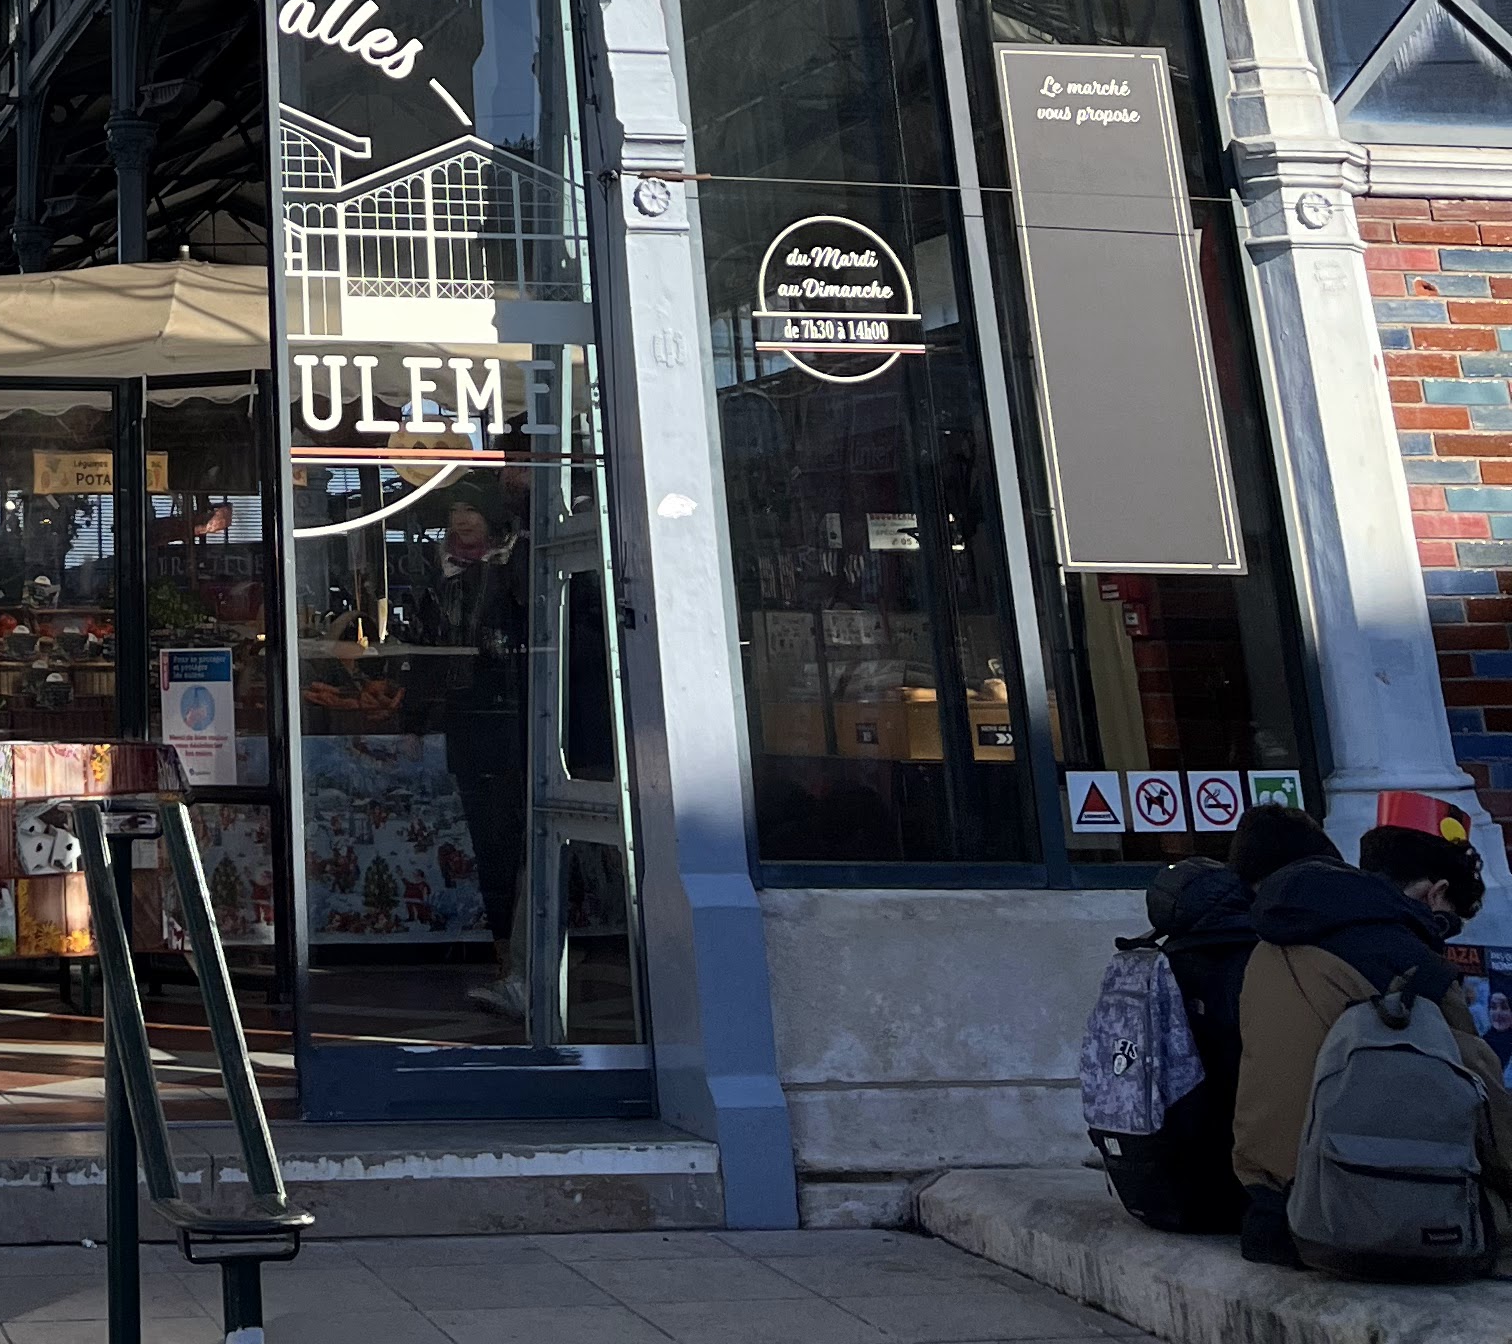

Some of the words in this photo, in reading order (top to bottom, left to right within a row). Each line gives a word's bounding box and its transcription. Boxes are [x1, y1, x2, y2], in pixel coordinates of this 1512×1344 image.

[1040, 75, 1063, 97] Le
[1067, 80, 1131, 96] marché
[1037, 107, 1071, 121] vous
[1076, 107, 1141, 126] propose
[786, 248, 811, 267] du
[811, 246, 878, 270] Mardi
[778, 282, 803, 297] au
[802, 278, 894, 299] Dimanche
[784, 319, 800, 339] de
[801, 320, 834, 339] 7h30
[837, 320, 846, 339] à
[848, 320, 889, 340] 14h00
